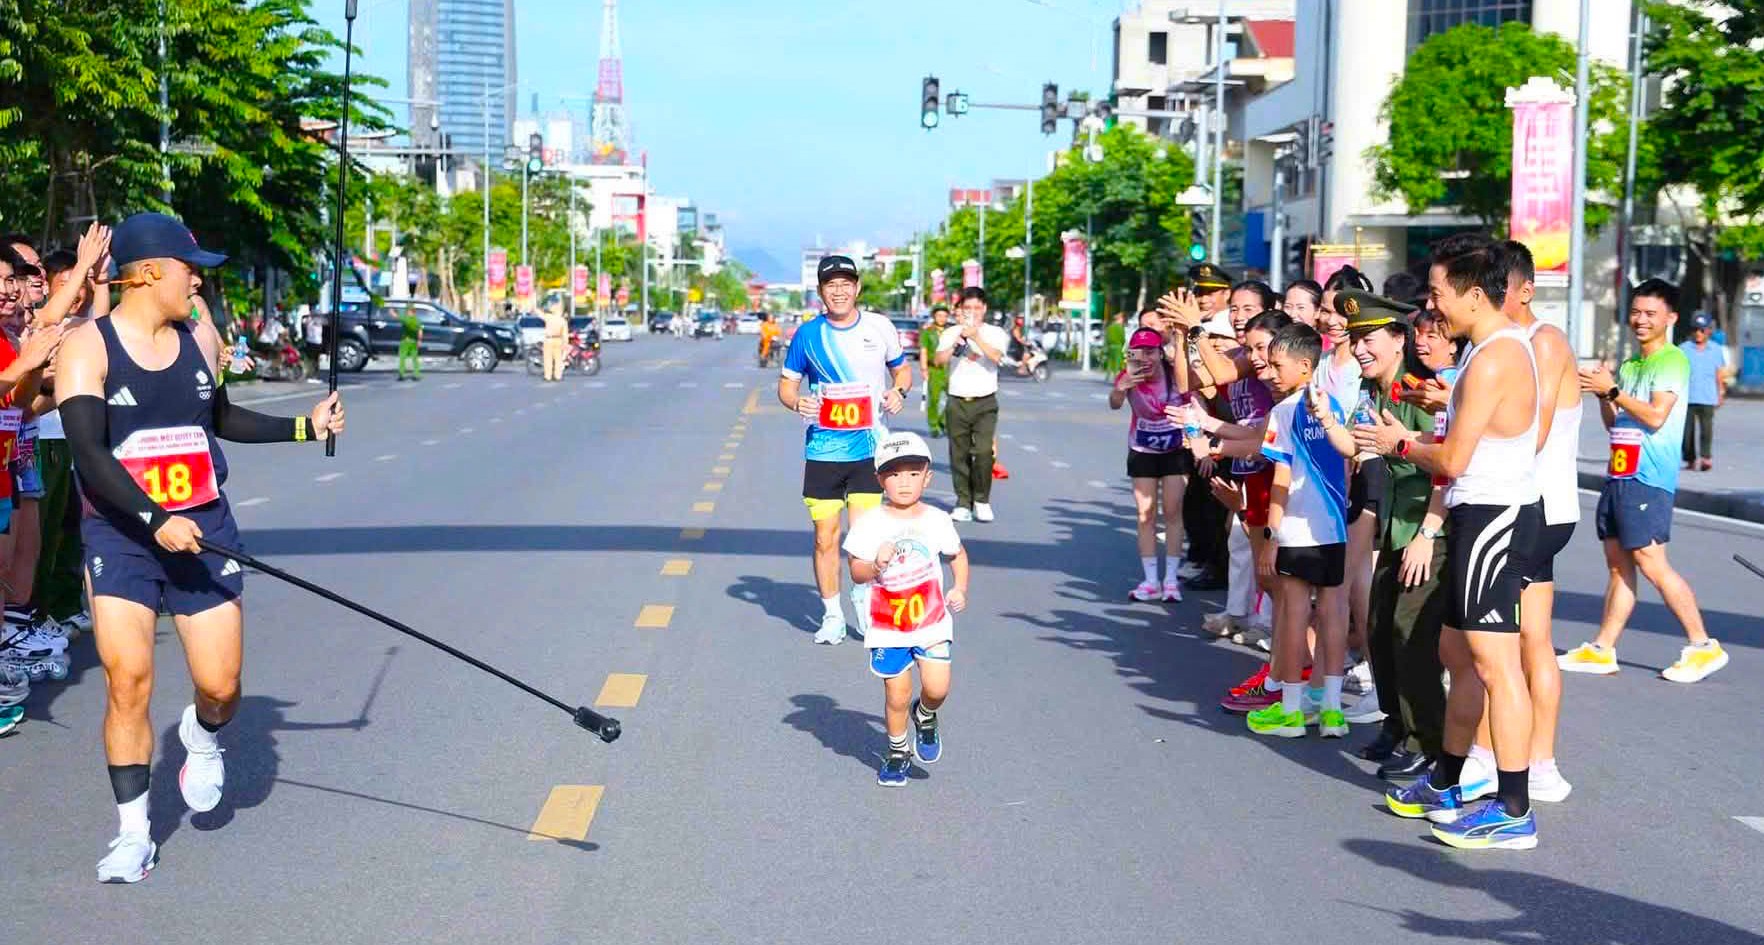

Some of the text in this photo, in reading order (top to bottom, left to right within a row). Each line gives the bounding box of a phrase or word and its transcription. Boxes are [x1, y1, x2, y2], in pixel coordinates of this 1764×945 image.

[829, 402, 860, 426] 40
[1147, 434, 1173, 450] 27
[143, 463, 193, 504] 18
[888, 592, 926, 627] 70
